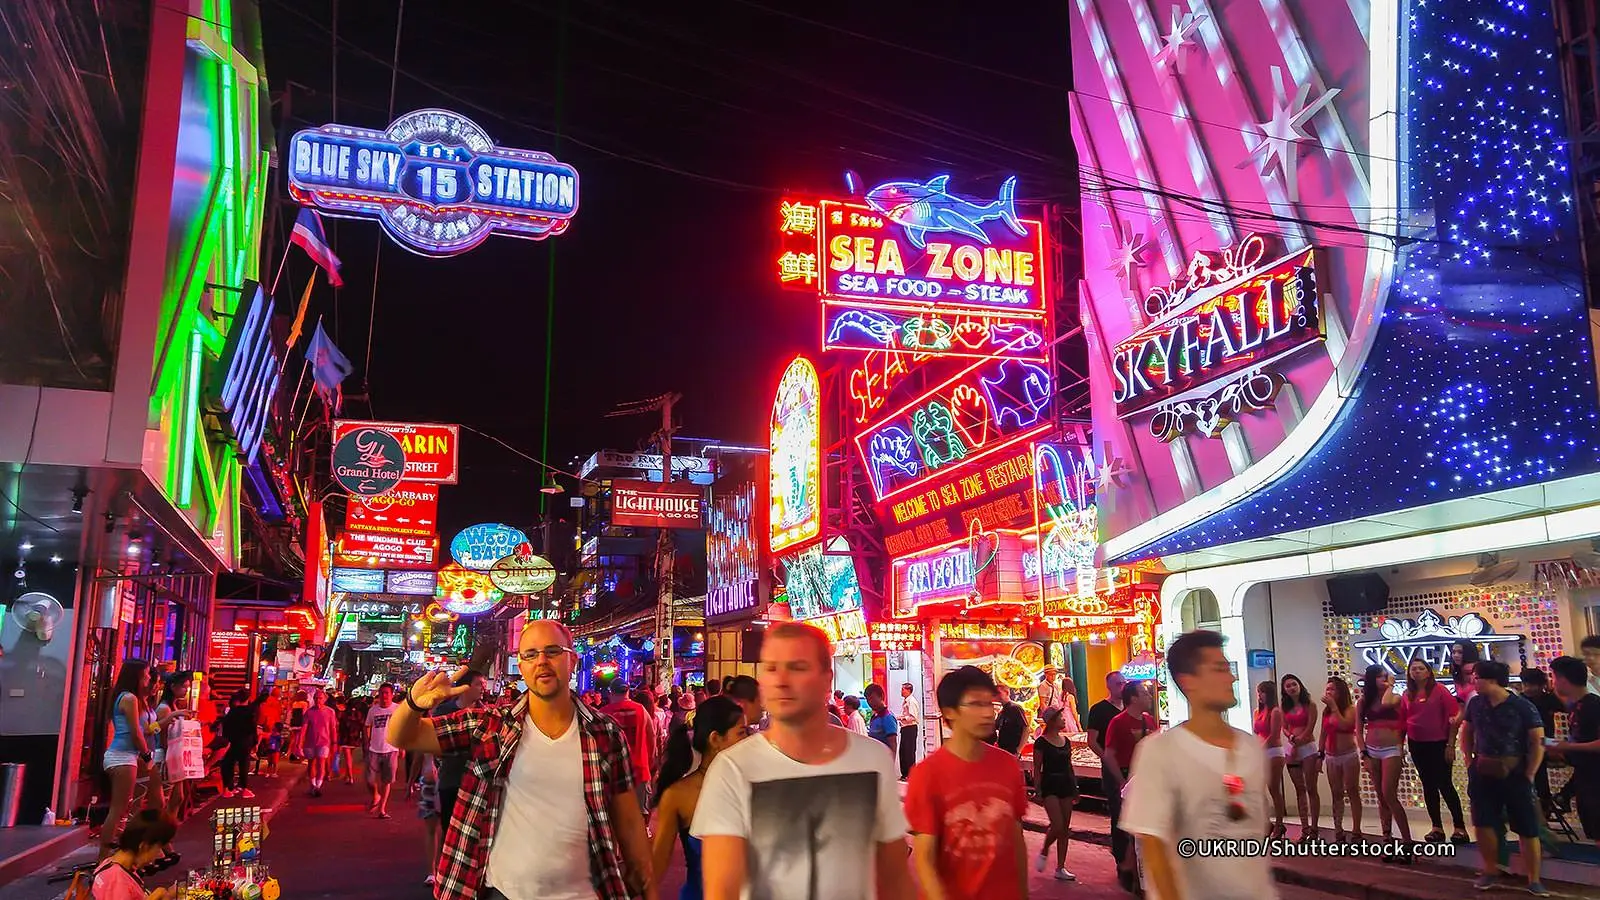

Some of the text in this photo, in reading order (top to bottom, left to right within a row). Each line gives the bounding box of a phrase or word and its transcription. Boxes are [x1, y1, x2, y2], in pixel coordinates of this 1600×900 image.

[295, 140, 401, 186] BLUE SKY
[416, 166, 458, 199] 15
[477, 163, 574, 208] STATION
[829, 234, 1035, 287] SEA ZONE
[838, 273, 880, 293] SEA
[886, 279, 942, 298] FOOD
[964, 283, 1029, 304] STEAK
[1112, 278, 1293, 403] SKYFALL
[401, 434, 448, 455] ARIN
[337, 465, 401, 480] Grand Hotel
[405, 461, 440, 473] STREET
[371, 495, 416, 507] AGO-GO
[387, 489, 436, 502] GARBABY
[616, 488, 638, 496] THE
[892, 494, 930, 524] WELCOME
[926, 489, 941, 511] TO
[940, 482, 961, 507] SEA
[960, 473, 987, 500] ZONE
[615, 495, 699, 513] LIGHTHOUSE
[350, 533, 427, 546] THE WINDMILL CLUB
[464, 526, 522, 546] WOOD
[372, 543, 403, 552] AGOGO
[705, 580, 755, 617] LIGHTHOUSE
